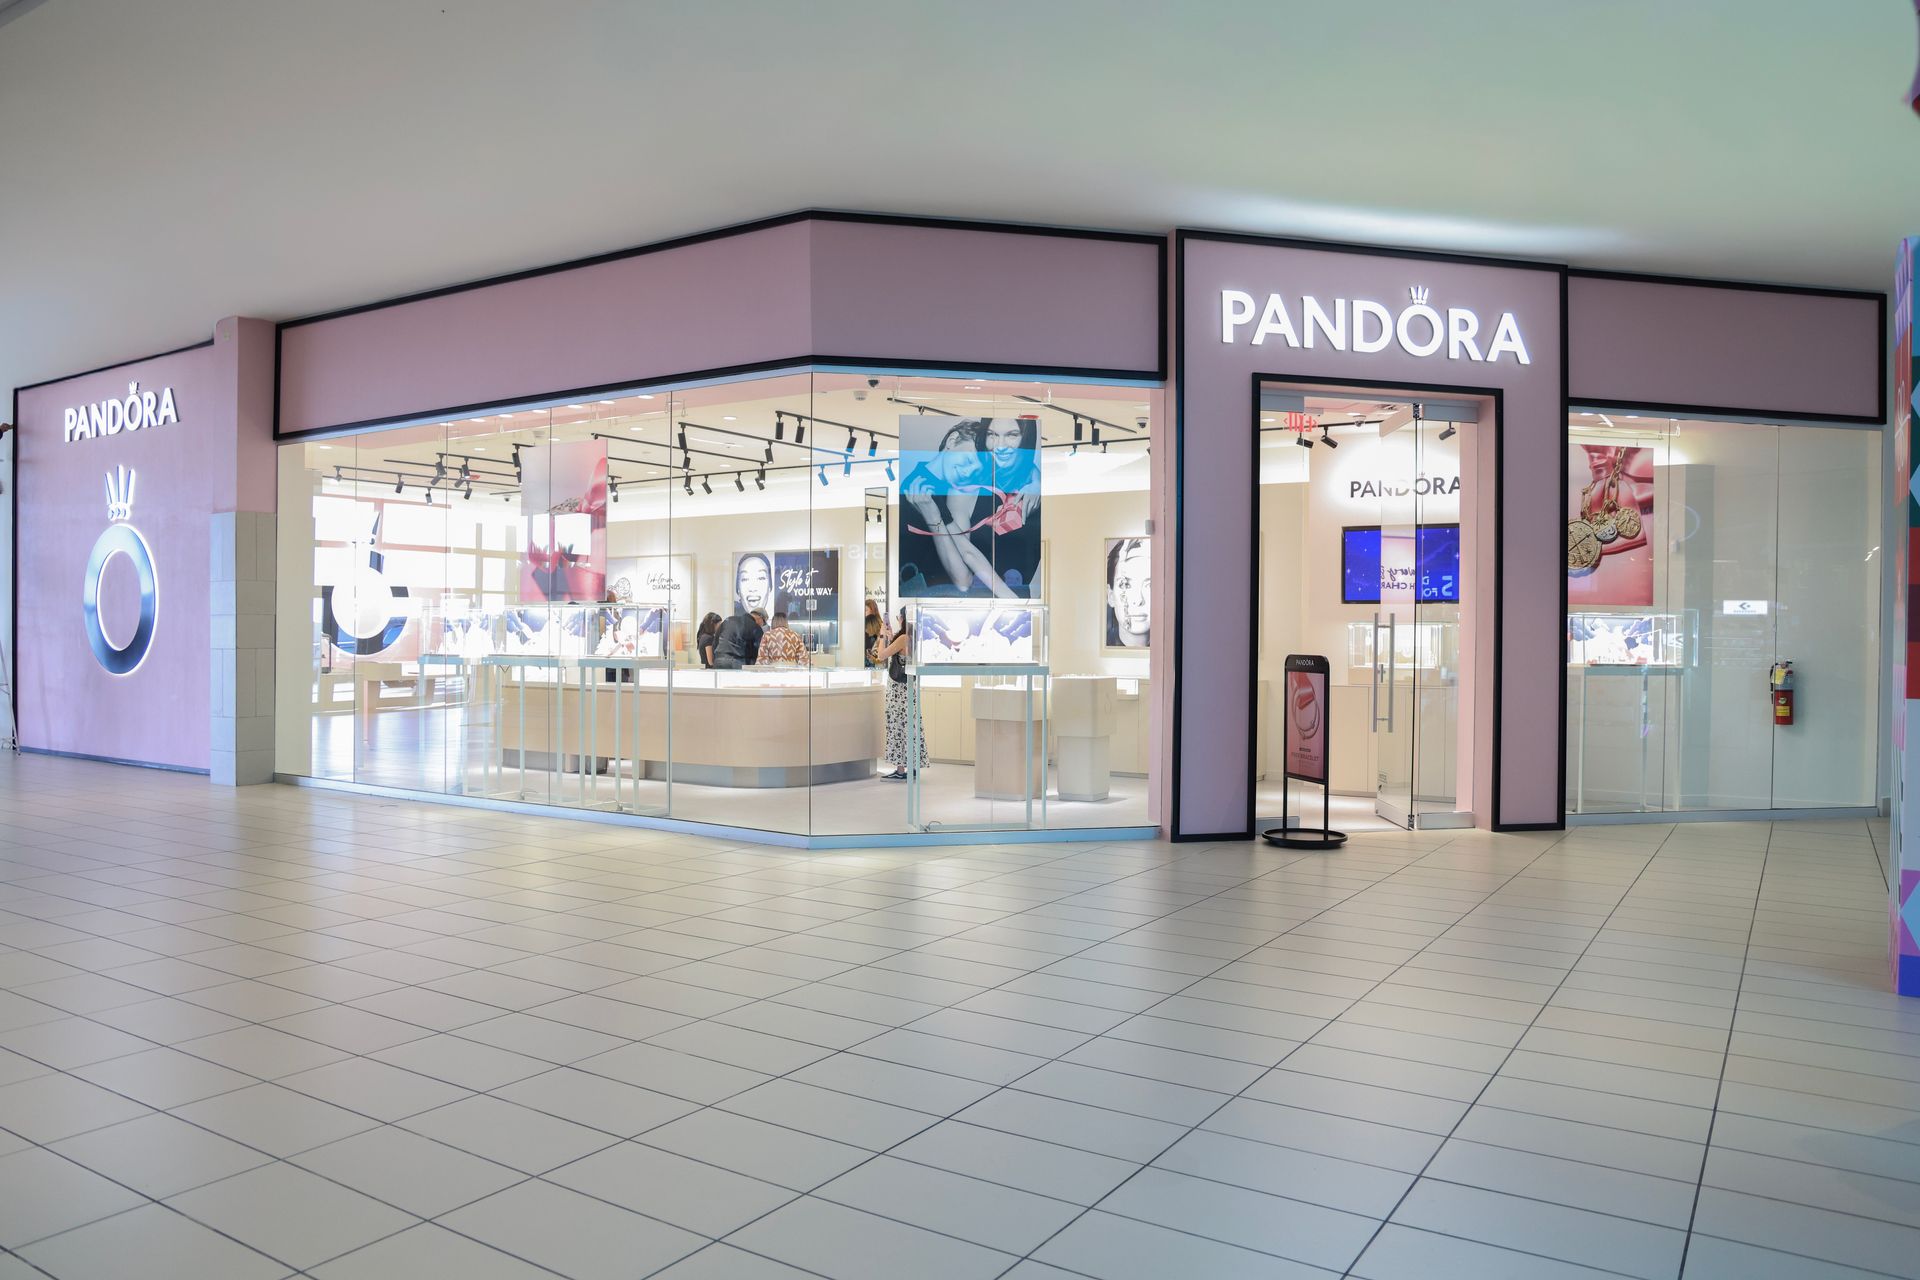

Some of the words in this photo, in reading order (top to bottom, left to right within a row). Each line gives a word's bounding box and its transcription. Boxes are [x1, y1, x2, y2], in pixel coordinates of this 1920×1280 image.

[1221, 286, 1530, 364] PANDORA
[65, 381, 179, 442] PANDORA
[779, 569, 802, 593] Style
[804, 568, 819, 589] it
[793, 588, 815, 597] YOUR
[816, 587, 833, 596] WAY
[1296, 658, 1314, 666] PANDORA
